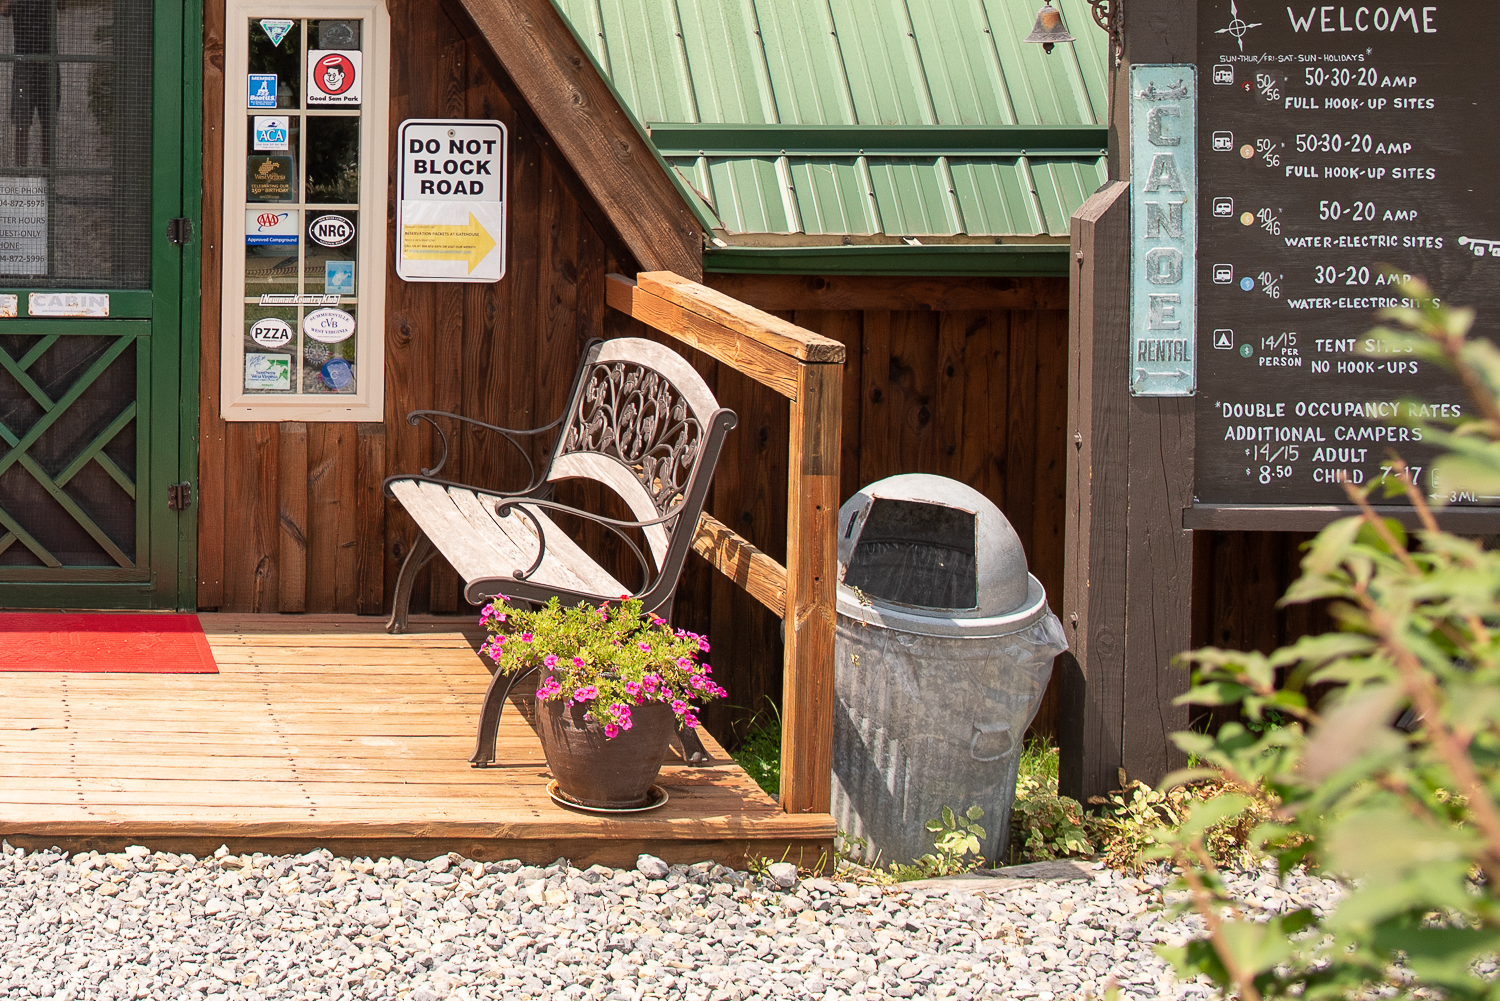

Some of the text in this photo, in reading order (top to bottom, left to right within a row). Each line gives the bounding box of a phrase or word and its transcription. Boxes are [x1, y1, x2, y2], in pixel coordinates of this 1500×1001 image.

[1286, 6, 1438, 33] WELCOME
[1381, 76, 1418, 88] AMP
[1285, 97, 1435, 110] FULL HOOK-UP SITES
[259, 129, 284, 142] ACA
[409, 138, 497, 155] DO NOT
[1375, 142, 1412, 154] AMP
[413, 159, 492, 175] BLOCK
[1285, 166, 1436, 180] FULL HOOK-UP SITES
[21, 186, 48, 194] PHONE
[420, 179, 484, 195] ROAD
[1143, 104, 1186, 331] CANOE
[1319, 201, 1376, 221] 50-20
[1383, 209, 1418, 221] AMP
[18, 216, 46, 225] HOURS
[257, 213, 279, 227] AAA
[318, 224, 346, 238] NRG
[1285, 236, 1443, 249] WATER-ELECTRIC SITES
[1314, 265, 1370, 285] 30-20
[1375, 274, 1412, 286] AMP
[33, 294, 106, 308] CABIN
[1287, 298, 1398, 309] WATER-ELECTRIC
[309, 312, 350, 322] SUMMERSVILLE
[320, 317, 338, 328] CVB
[254, 327, 289, 340] PZZA
[1261, 332, 1297, 350] 14/15
[1315, 339, 1356, 353] TENT
[1136, 338, 1191, 363] RENTAL
[1281, 348, 1299, 356] PER
[1259, 357, 1418, 374] PERSON NO HOOK-UPS
[1223, 402, 1461, 418] DOUBLE OCCUPANCY RATES
[1224, 426, 1423, 441] ADDITIONAL CAMPERS
[1312, 448, 1368, 462] ADULT
[1313, 468, 1364, 484] CHILD
[1449, 490, 1457, 502] 3
